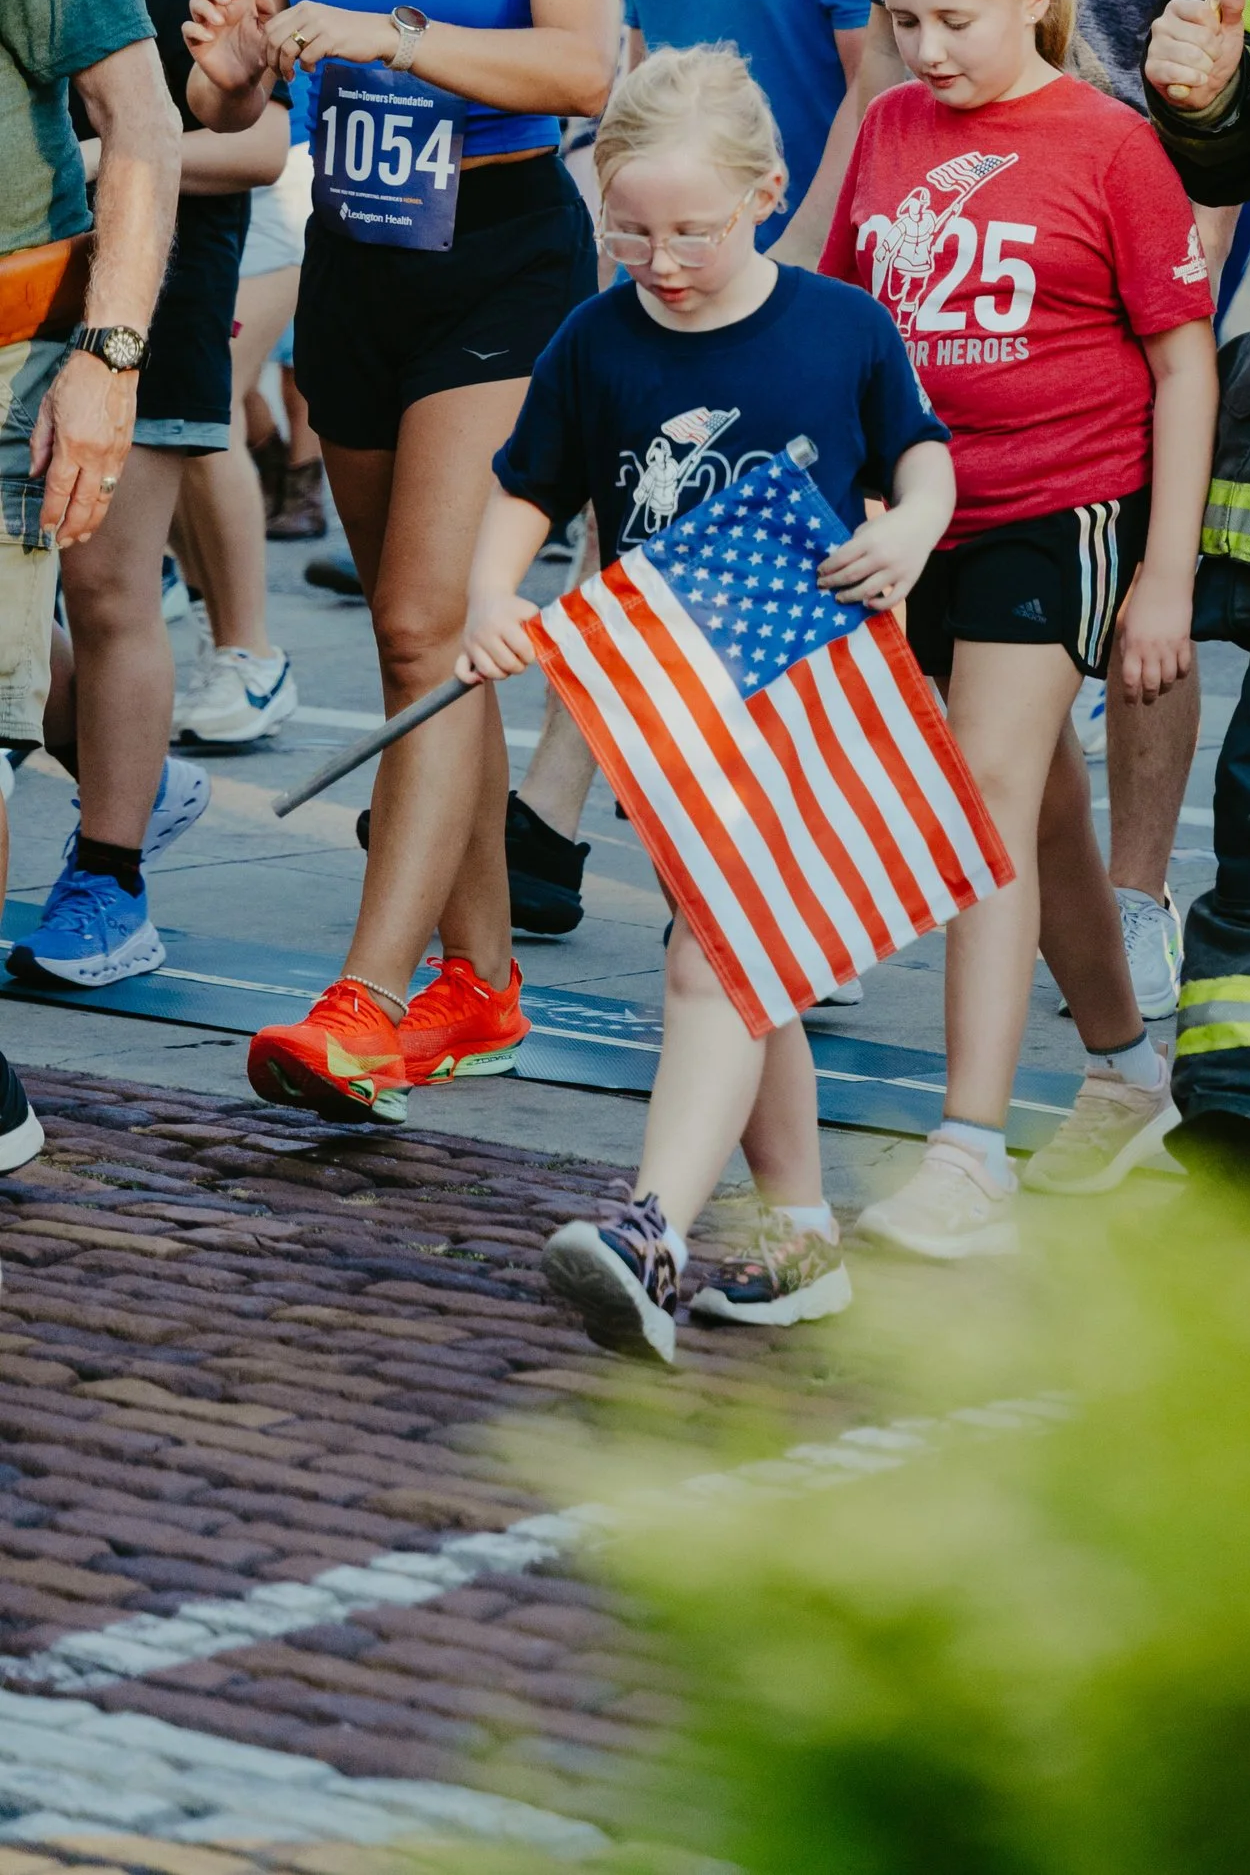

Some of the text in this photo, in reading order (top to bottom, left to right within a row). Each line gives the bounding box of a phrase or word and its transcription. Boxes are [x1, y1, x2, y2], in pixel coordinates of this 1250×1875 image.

[362, 90, 389, 104] Towers
[388, 93, 434, 108] Foundation
[322, 105, 455, 190] 1054
[347, 208, 413, 226] Lexington Health
[936, 336, 1029, 366] HEROES
